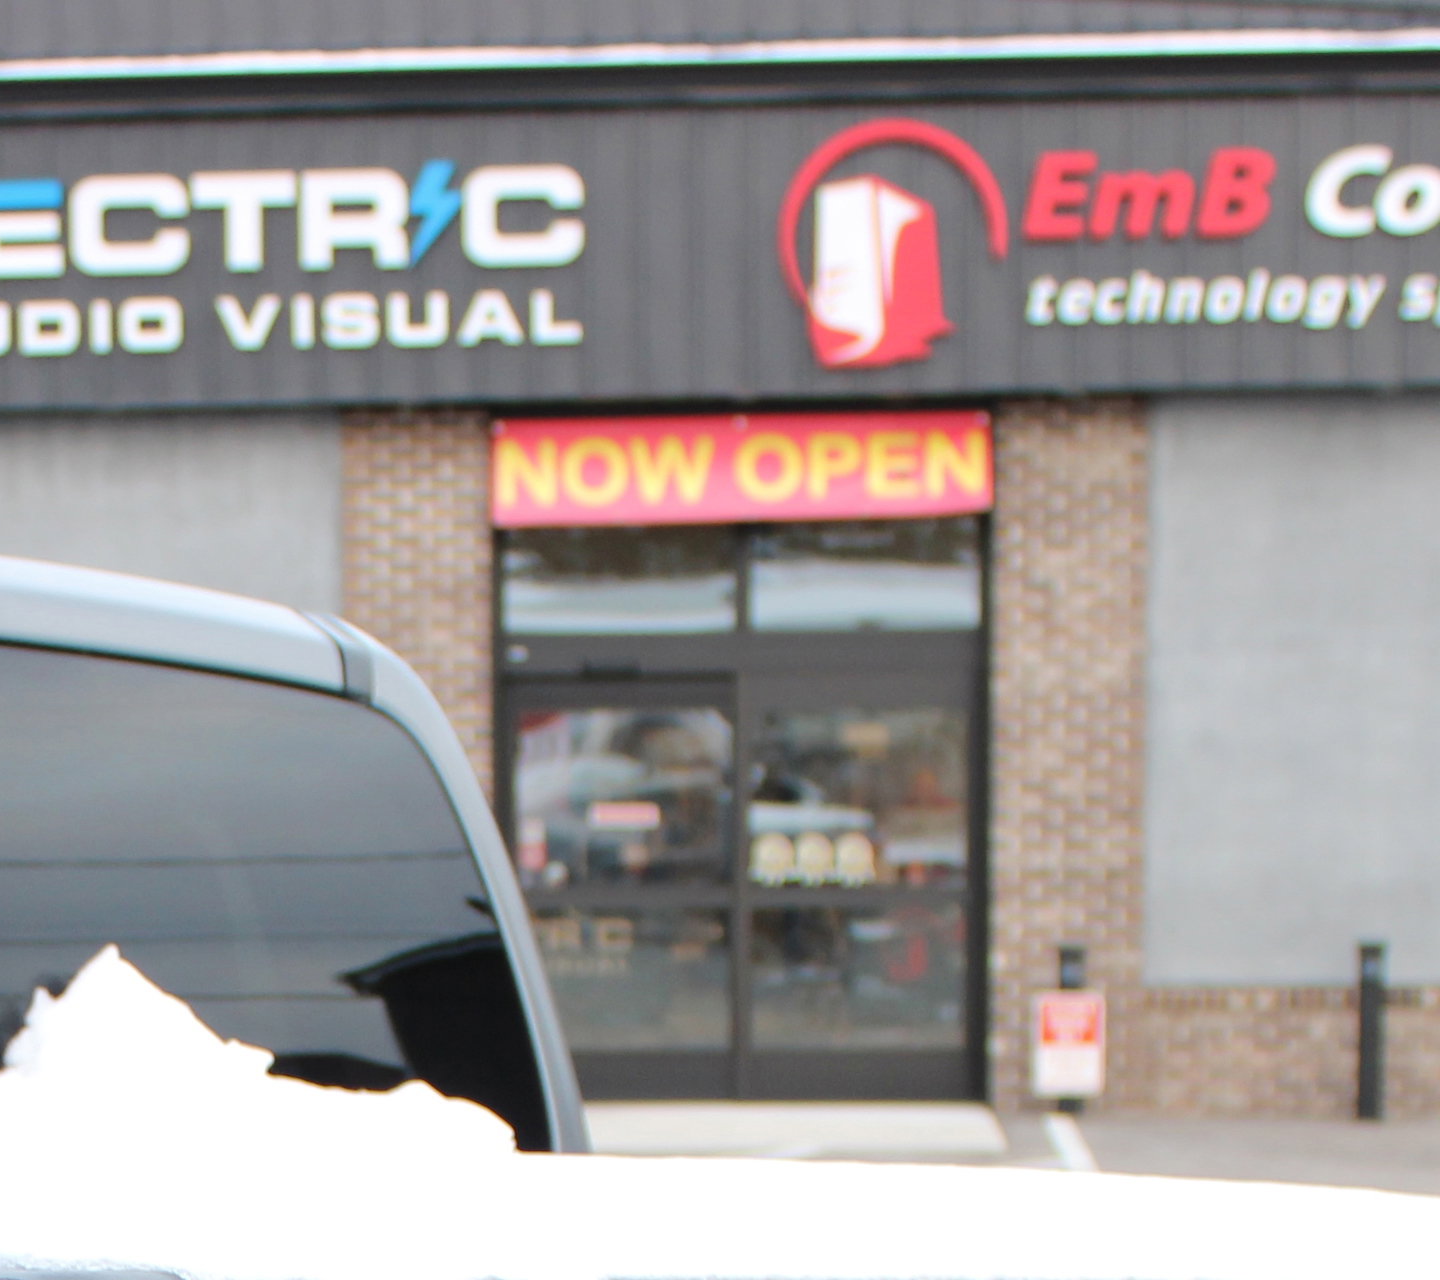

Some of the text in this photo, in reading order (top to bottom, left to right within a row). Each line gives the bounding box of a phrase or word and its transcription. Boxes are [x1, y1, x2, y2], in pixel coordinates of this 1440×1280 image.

[1020, 144, 1277, 242] EmB
[212, 289, 584, 352] VISUAL
[1023, 266, 1386, 330] technology
[496, 428, 988, 508] NOW OPEN
